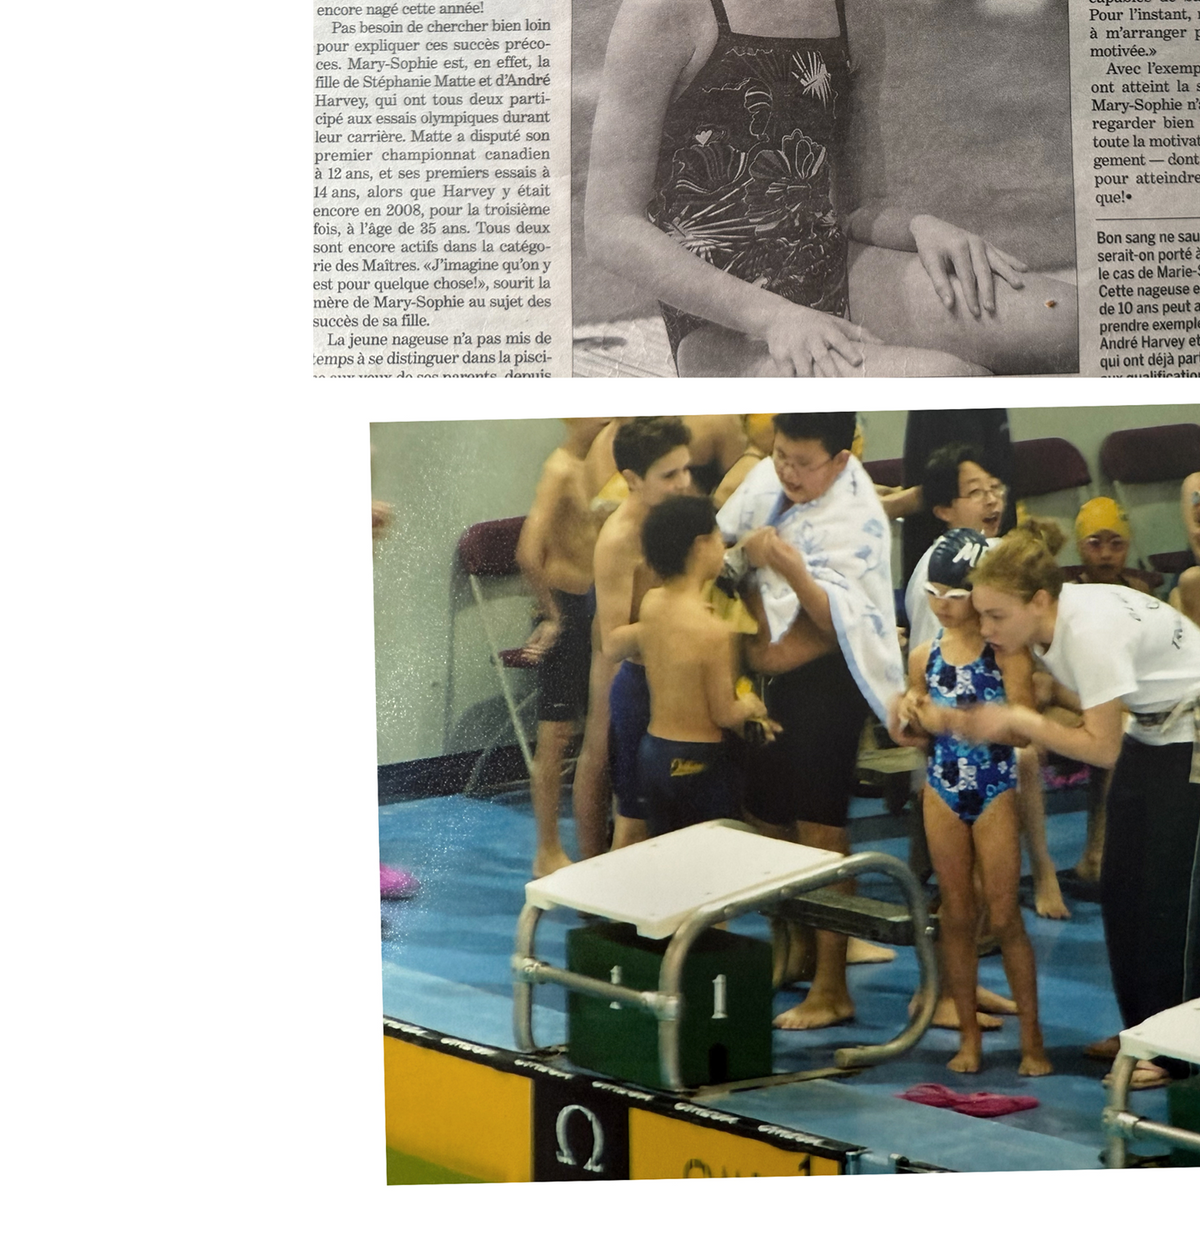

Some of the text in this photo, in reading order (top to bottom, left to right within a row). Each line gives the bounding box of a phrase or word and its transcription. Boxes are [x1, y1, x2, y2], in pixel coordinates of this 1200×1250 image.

[1105, 61, 1141, 75] Avec
[313, 146, 551, 165] premier championnat canadien
[312, 201, 551, 220] encore en 2008, pour la troisième
[1096, 230, 1122, 245] Bon
[1124, 232, 1156, 247] sang
[1158, 232, 1175, 243] ne
[1096, 248, 1155, 263] serait-on
[1157, 246, 1193, 264] porté
[1097, 266, 1110, 281] le
[1112, 268, 1135, 280] cas
[1137, 265, 1154, 280] de
[1098, 283, 1134, 298] Cette
[1136, 284, 1190, 300] nageuse
[1098, 301, 1115, 316] de
[1117, 300, 1133, 315] 10
[1135, 303, 1159, 315] ans
[1162, 299, 1191, 316] peut
[312, 312, 430, 328] succès de sa fille.
[1099, 318, 1150, 336] prendre
[1099, 335, 1138, 350] André
[1141, 334, 1186, 351] Harvey
[1099, 353, 1120, 371] qui
[1122, 352, 1145, 368] ont
[1147, 351, 1175, 369] déjà
[712, 974, 728, 1019] 1
